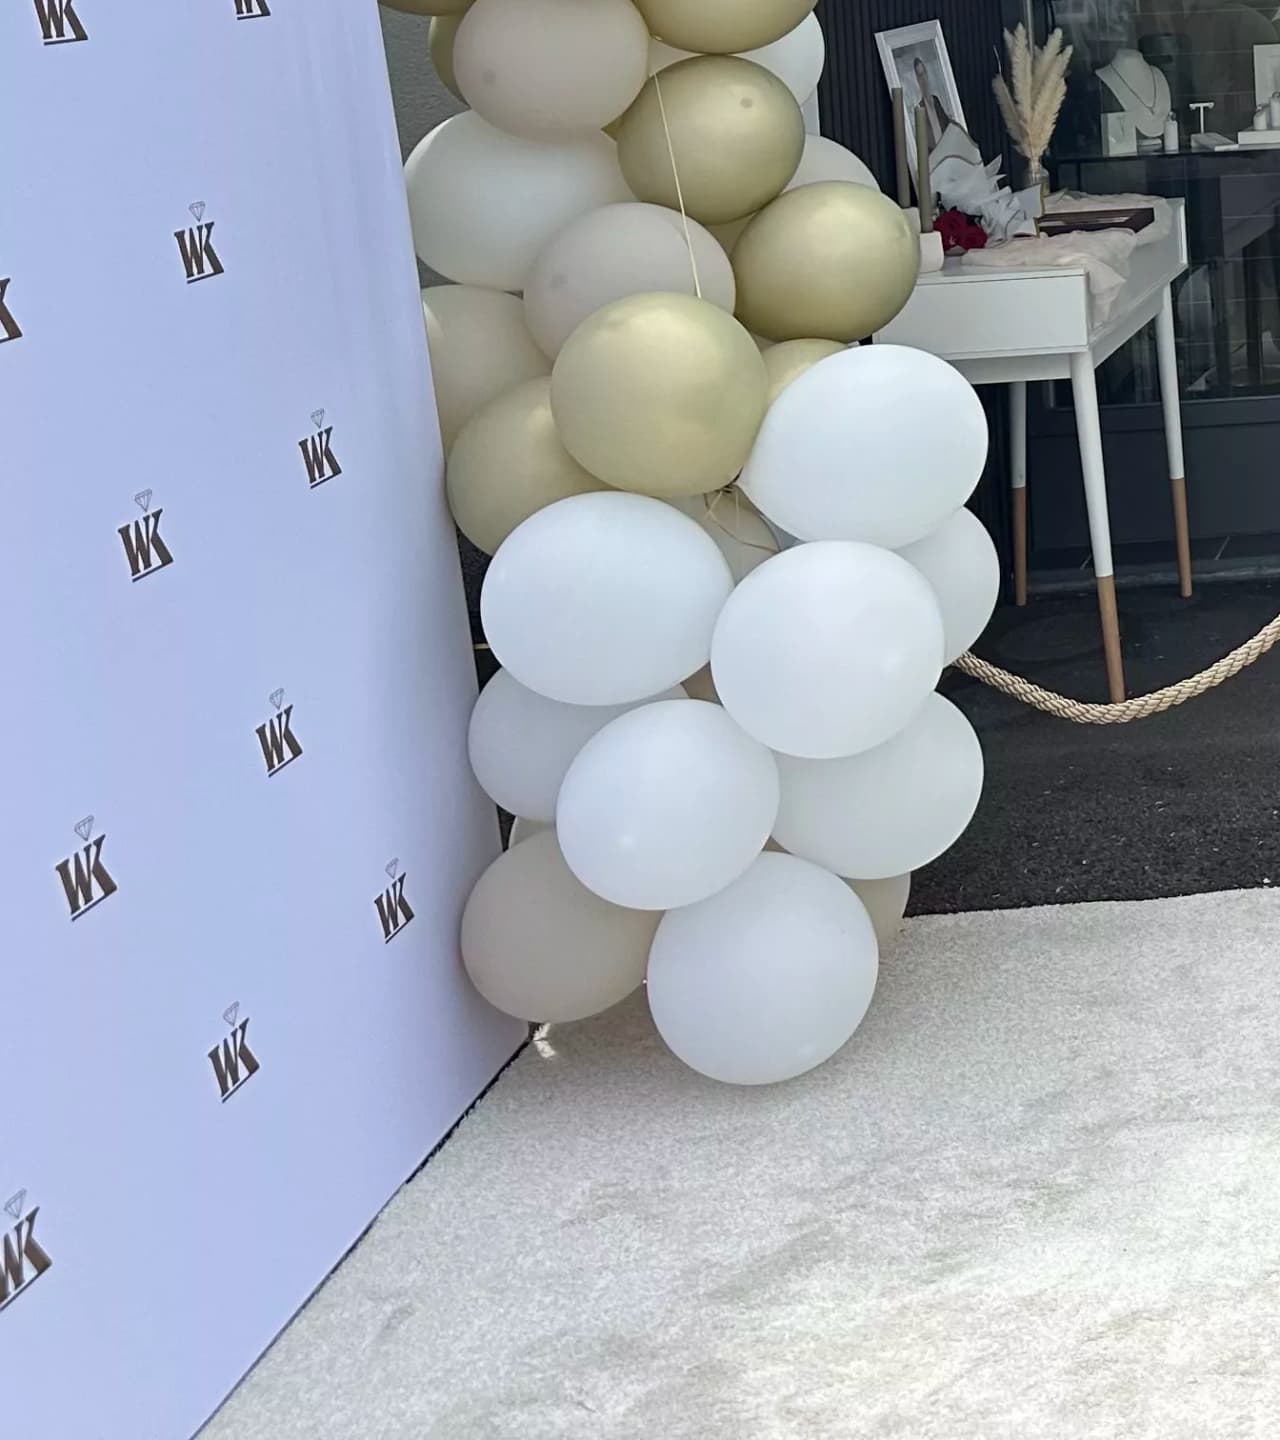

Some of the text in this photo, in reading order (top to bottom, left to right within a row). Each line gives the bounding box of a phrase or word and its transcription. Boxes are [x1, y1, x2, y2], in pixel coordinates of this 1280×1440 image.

[174, 221, 225, 284] WK
[299, 426, 342, 489] WK
[118, 508, 174, 583] WK
[256, 705, 303, 778] WK
[56, 834, 117, 922] WK
[374, 873, 415, 945] WK
[207, 1018, 260, 1103] WK
